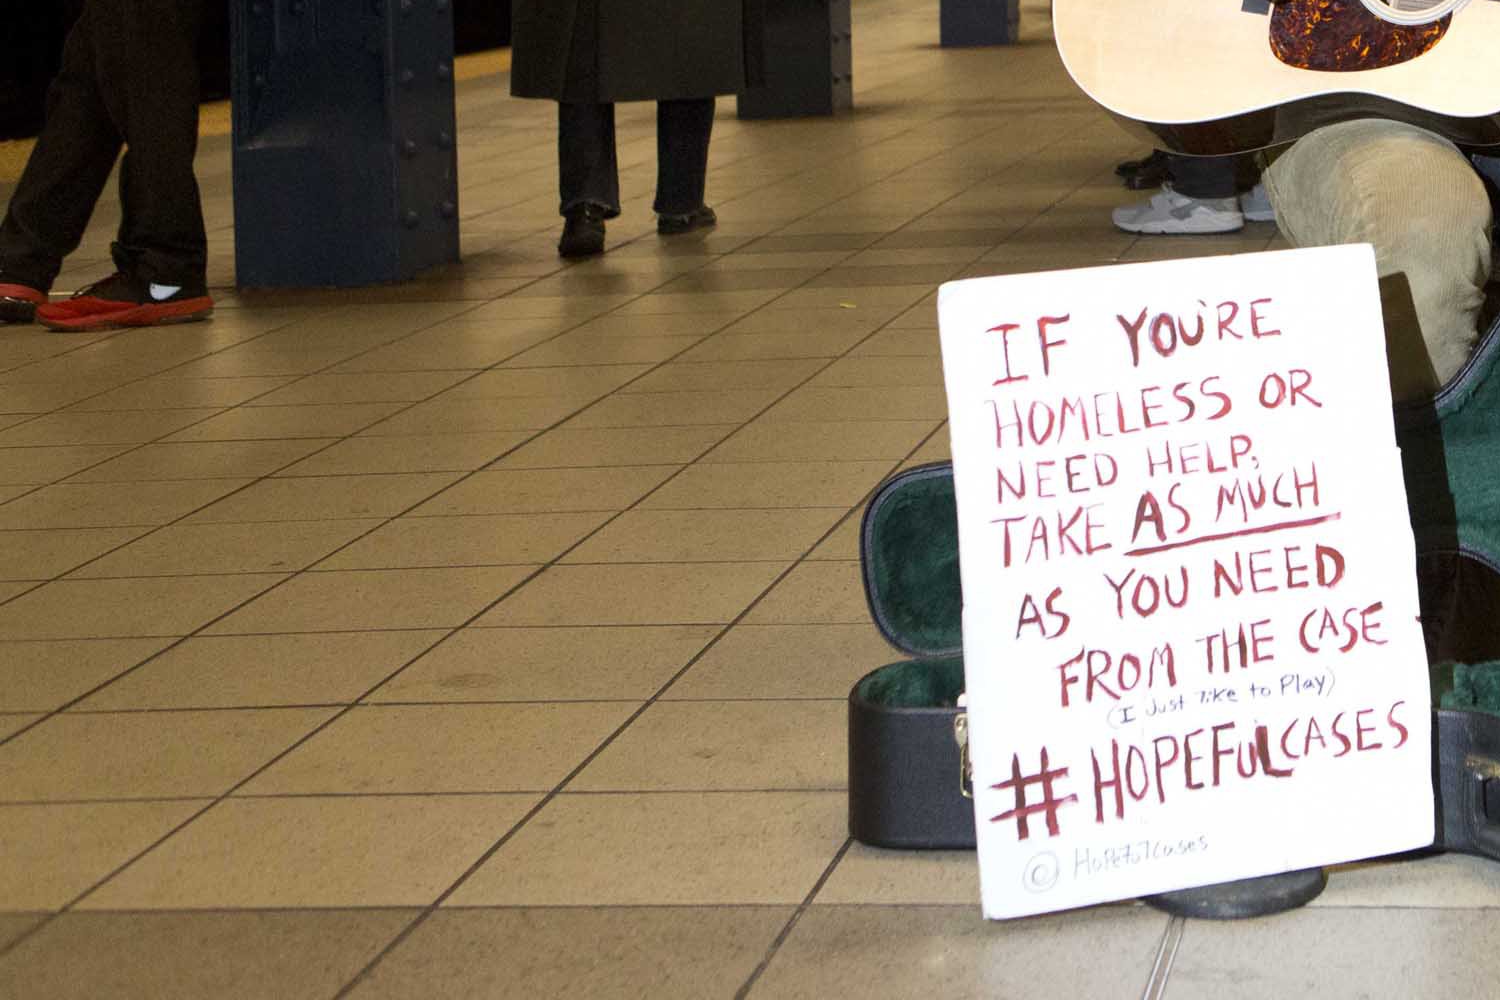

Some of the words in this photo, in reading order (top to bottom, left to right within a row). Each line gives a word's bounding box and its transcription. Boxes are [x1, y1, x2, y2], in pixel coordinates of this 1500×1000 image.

[985, 313, 1071, 386] IF
[1116, 297, 1282, 368] YOU'RE
[984, 376, 1232, 448] HOMELESS
[1258, 368, 1322, 409] OR
[989, 503, 1112, 568] TAKE
[1131, 482, 1191, 543] AS
[1215, 461, 1319, 523] MUCH
[997, 453, 1119, 504] NEED
[1016, 587, 1071, 640] AS
[1103, 565, 1189, 619] YOU
[1214, 544, 1345, 598] NEED
[1056, 643, 1176, 708] FROM
[1195, 618, 1275, 674] THE
[1299, 601, 1389, 654] CASE
[1249, 683, 1272, 697] to
